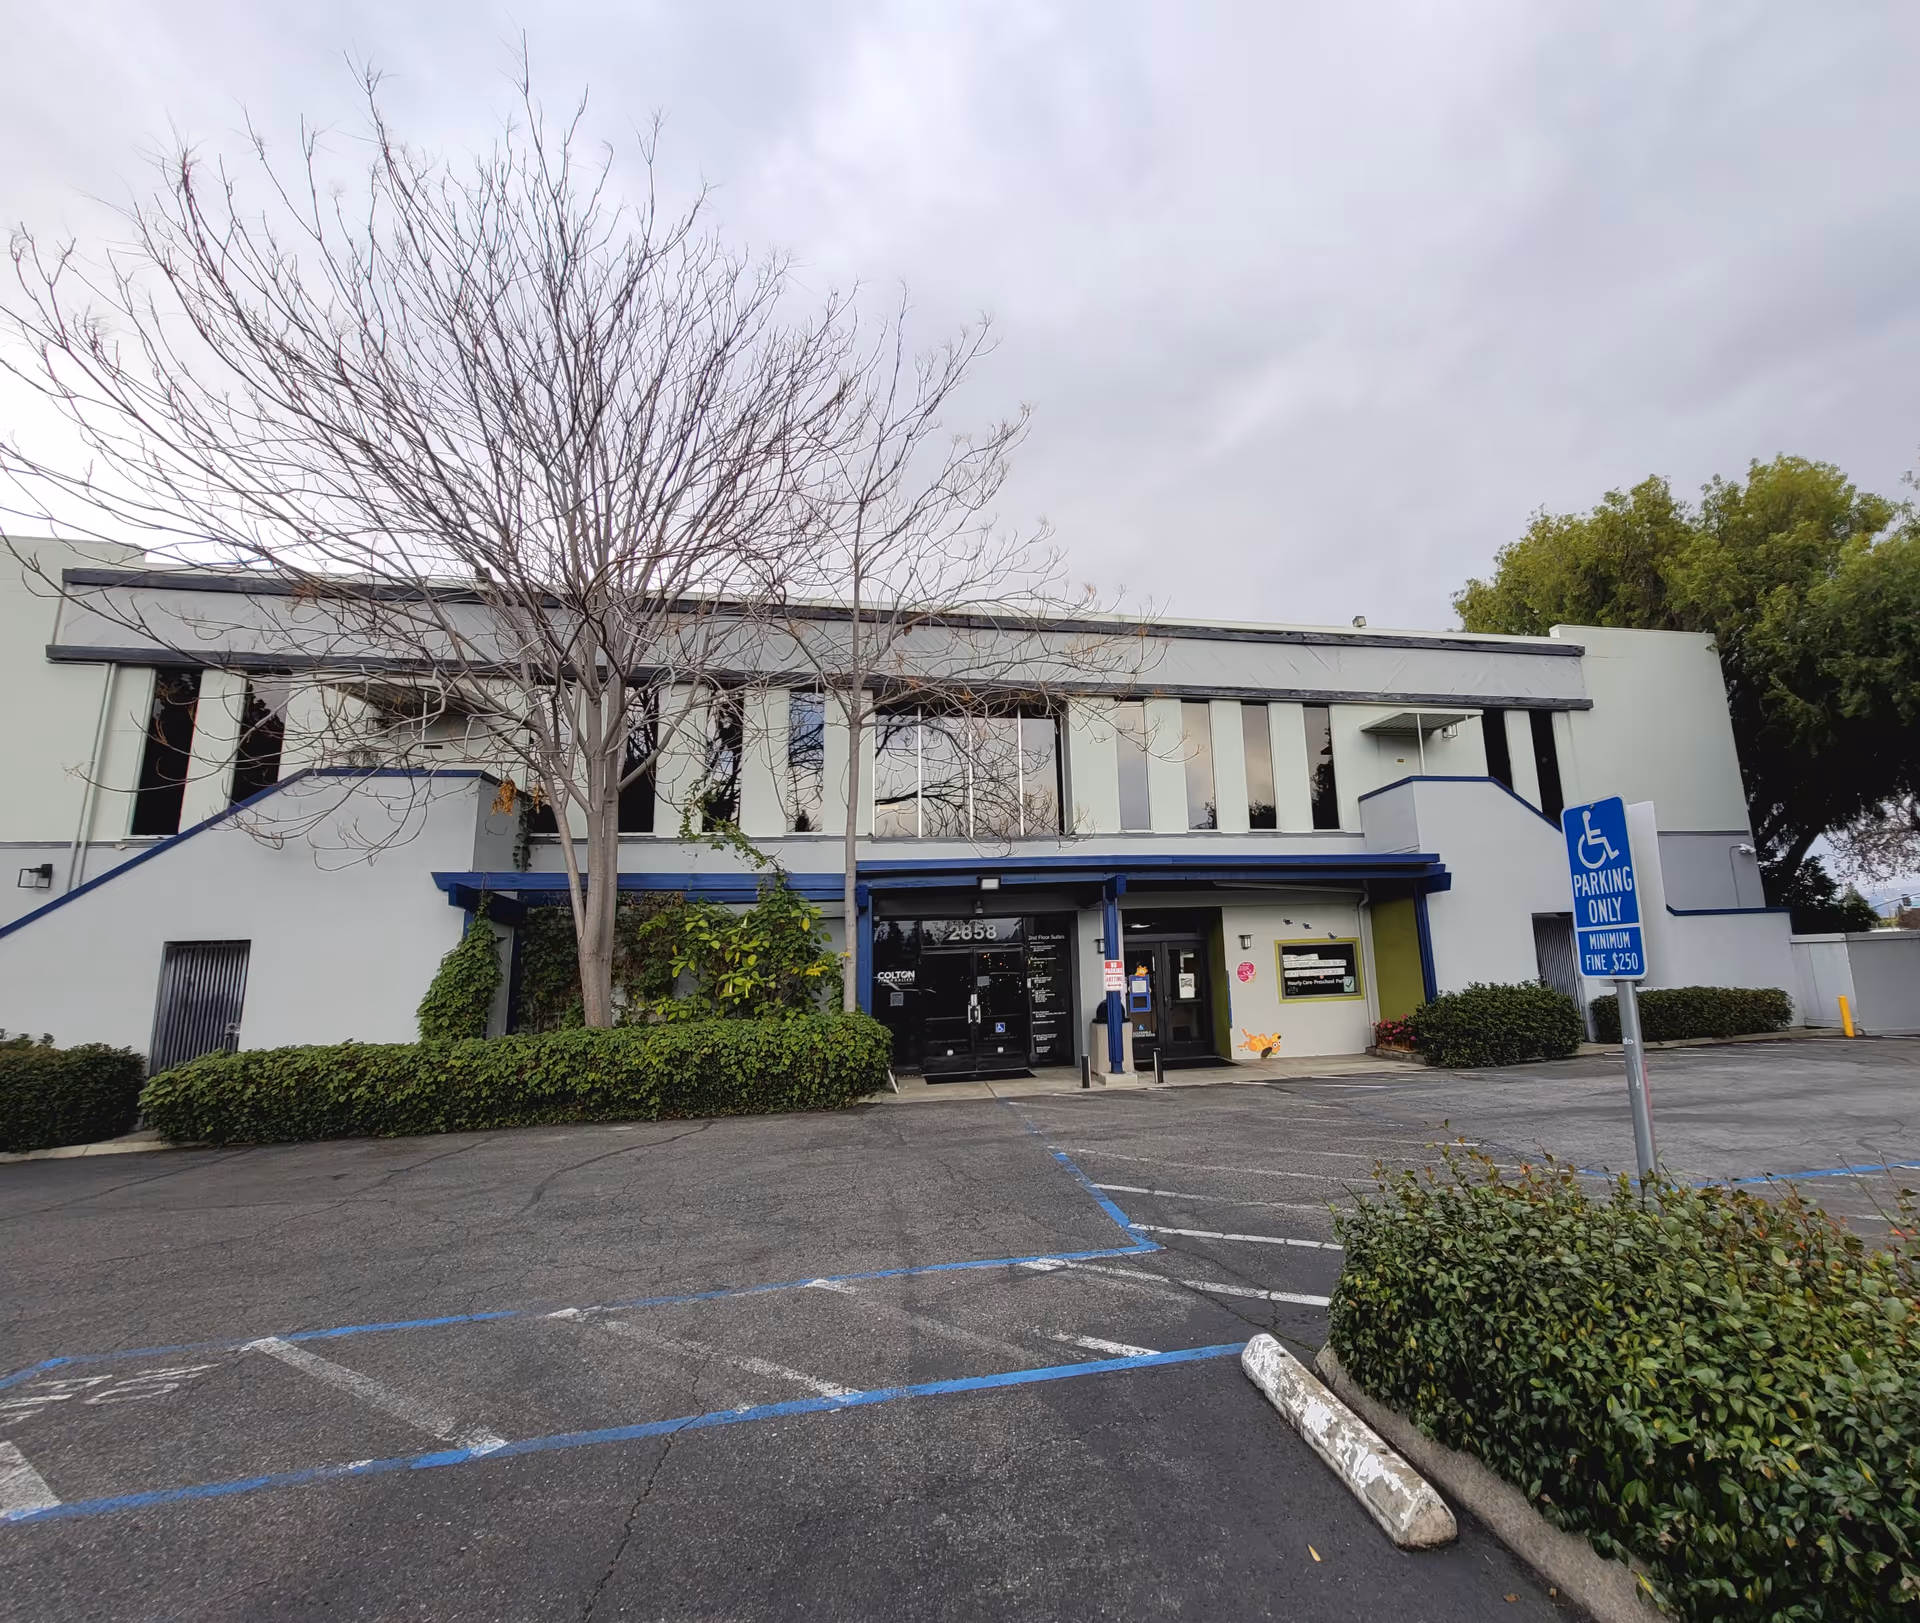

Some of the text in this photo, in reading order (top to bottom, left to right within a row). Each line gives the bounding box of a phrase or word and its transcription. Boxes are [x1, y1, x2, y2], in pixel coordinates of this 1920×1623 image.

[1573, 866, 1633, 898] PARKING
[1588, 897, 1622, 924] ONLY
[949, 924, 997, 940] 2858
[1589, 931, 1631, 950] MINIMUM
[1585, 952, 1639, 972] FINE $250
[877, 970, 915, 980] COLTON
